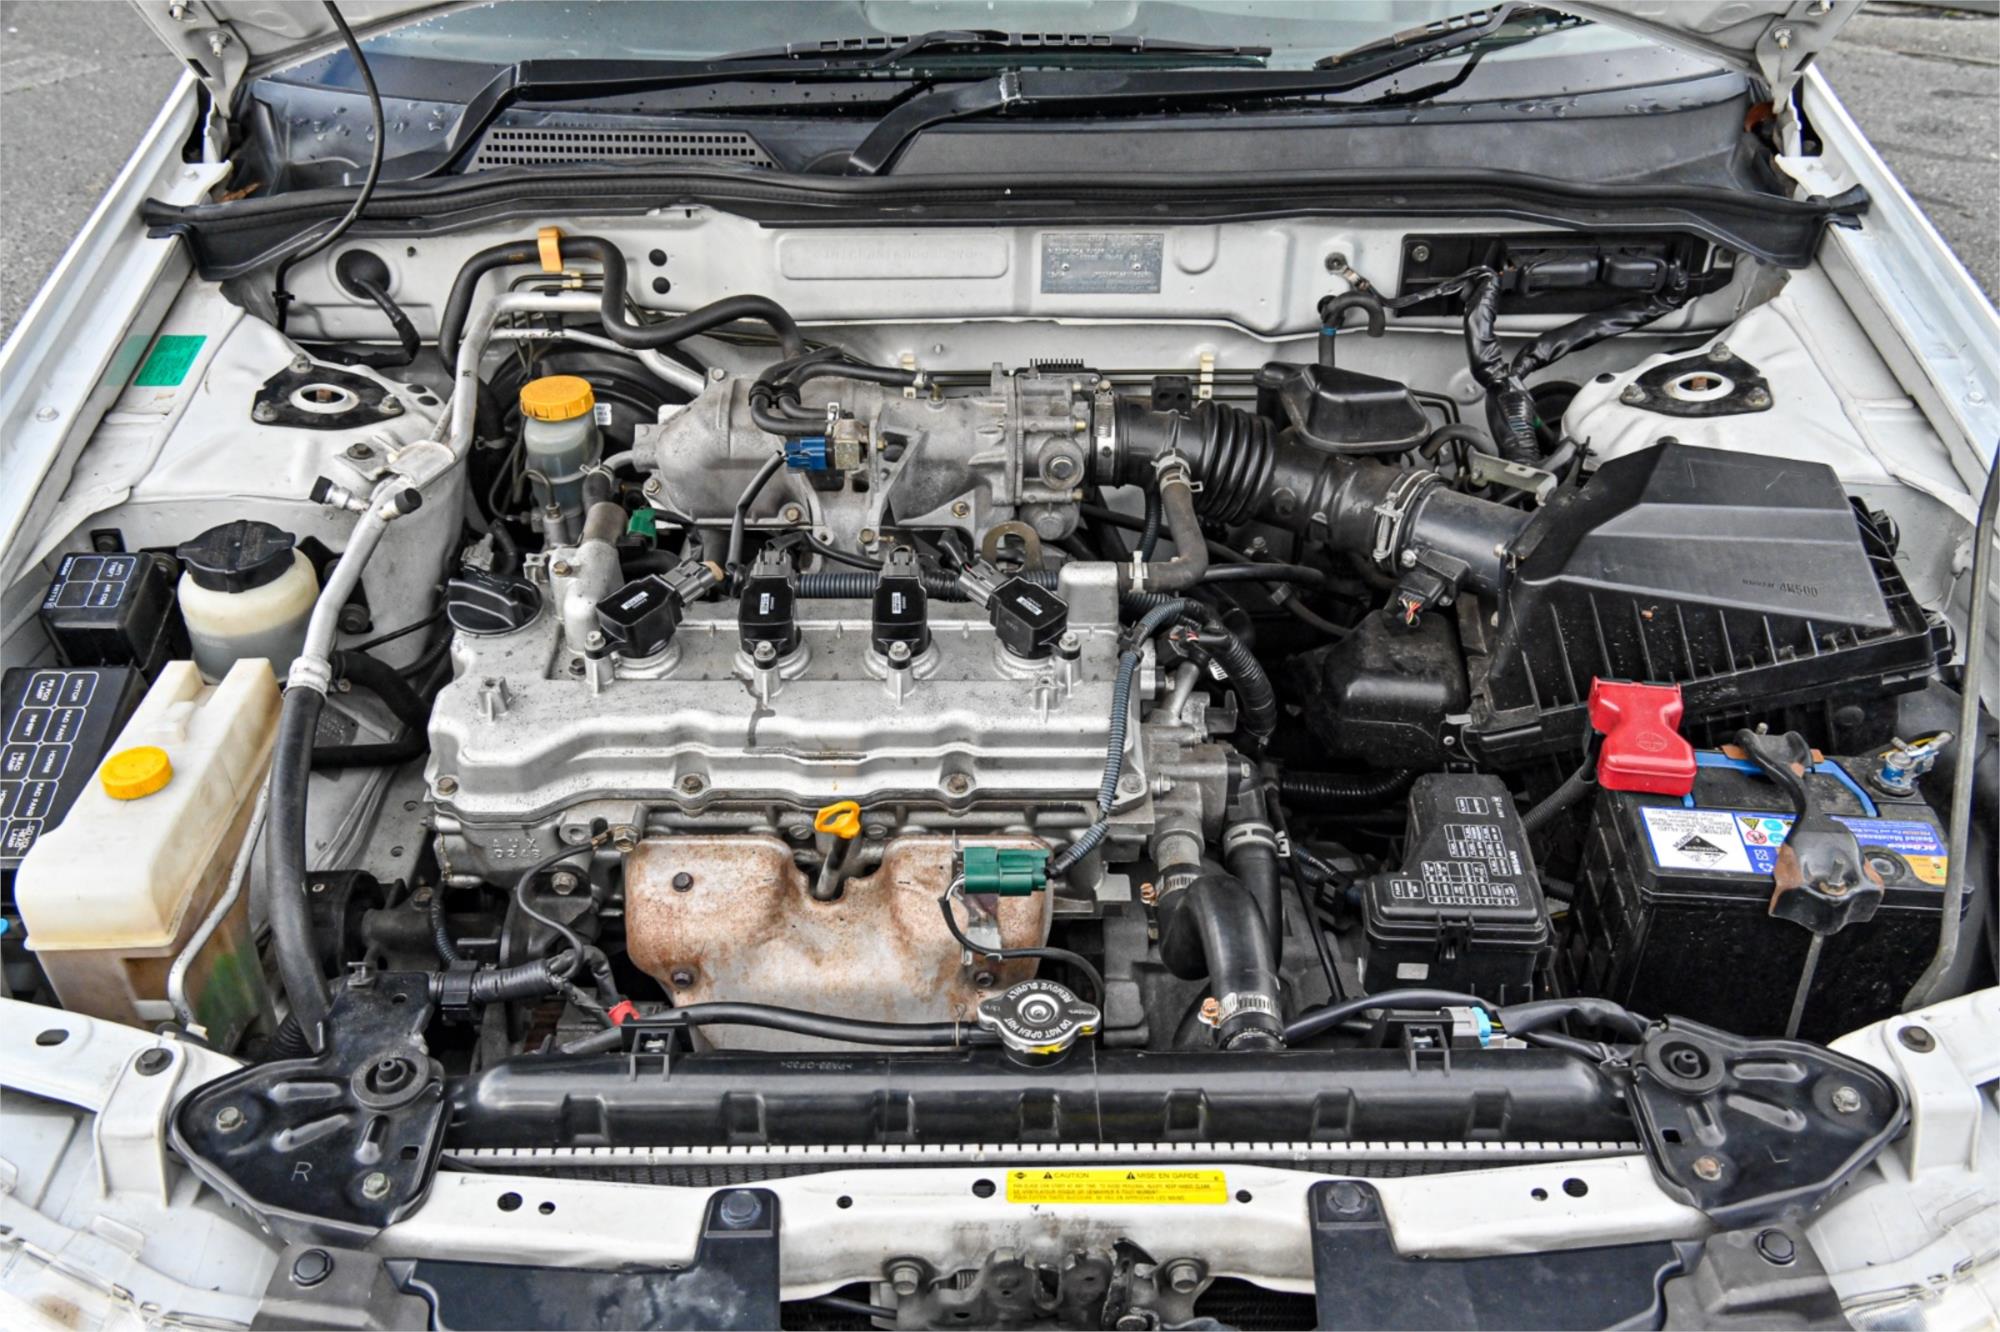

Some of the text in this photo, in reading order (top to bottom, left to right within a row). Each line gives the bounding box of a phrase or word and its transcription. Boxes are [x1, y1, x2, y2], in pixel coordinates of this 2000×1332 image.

[1006, 982, 1073, 1004] REMOVE SLOWLY
[1003, 1017, 1073, 1039] DO NOT OPEN HOT
[293, 1161, 313, 1182] R
